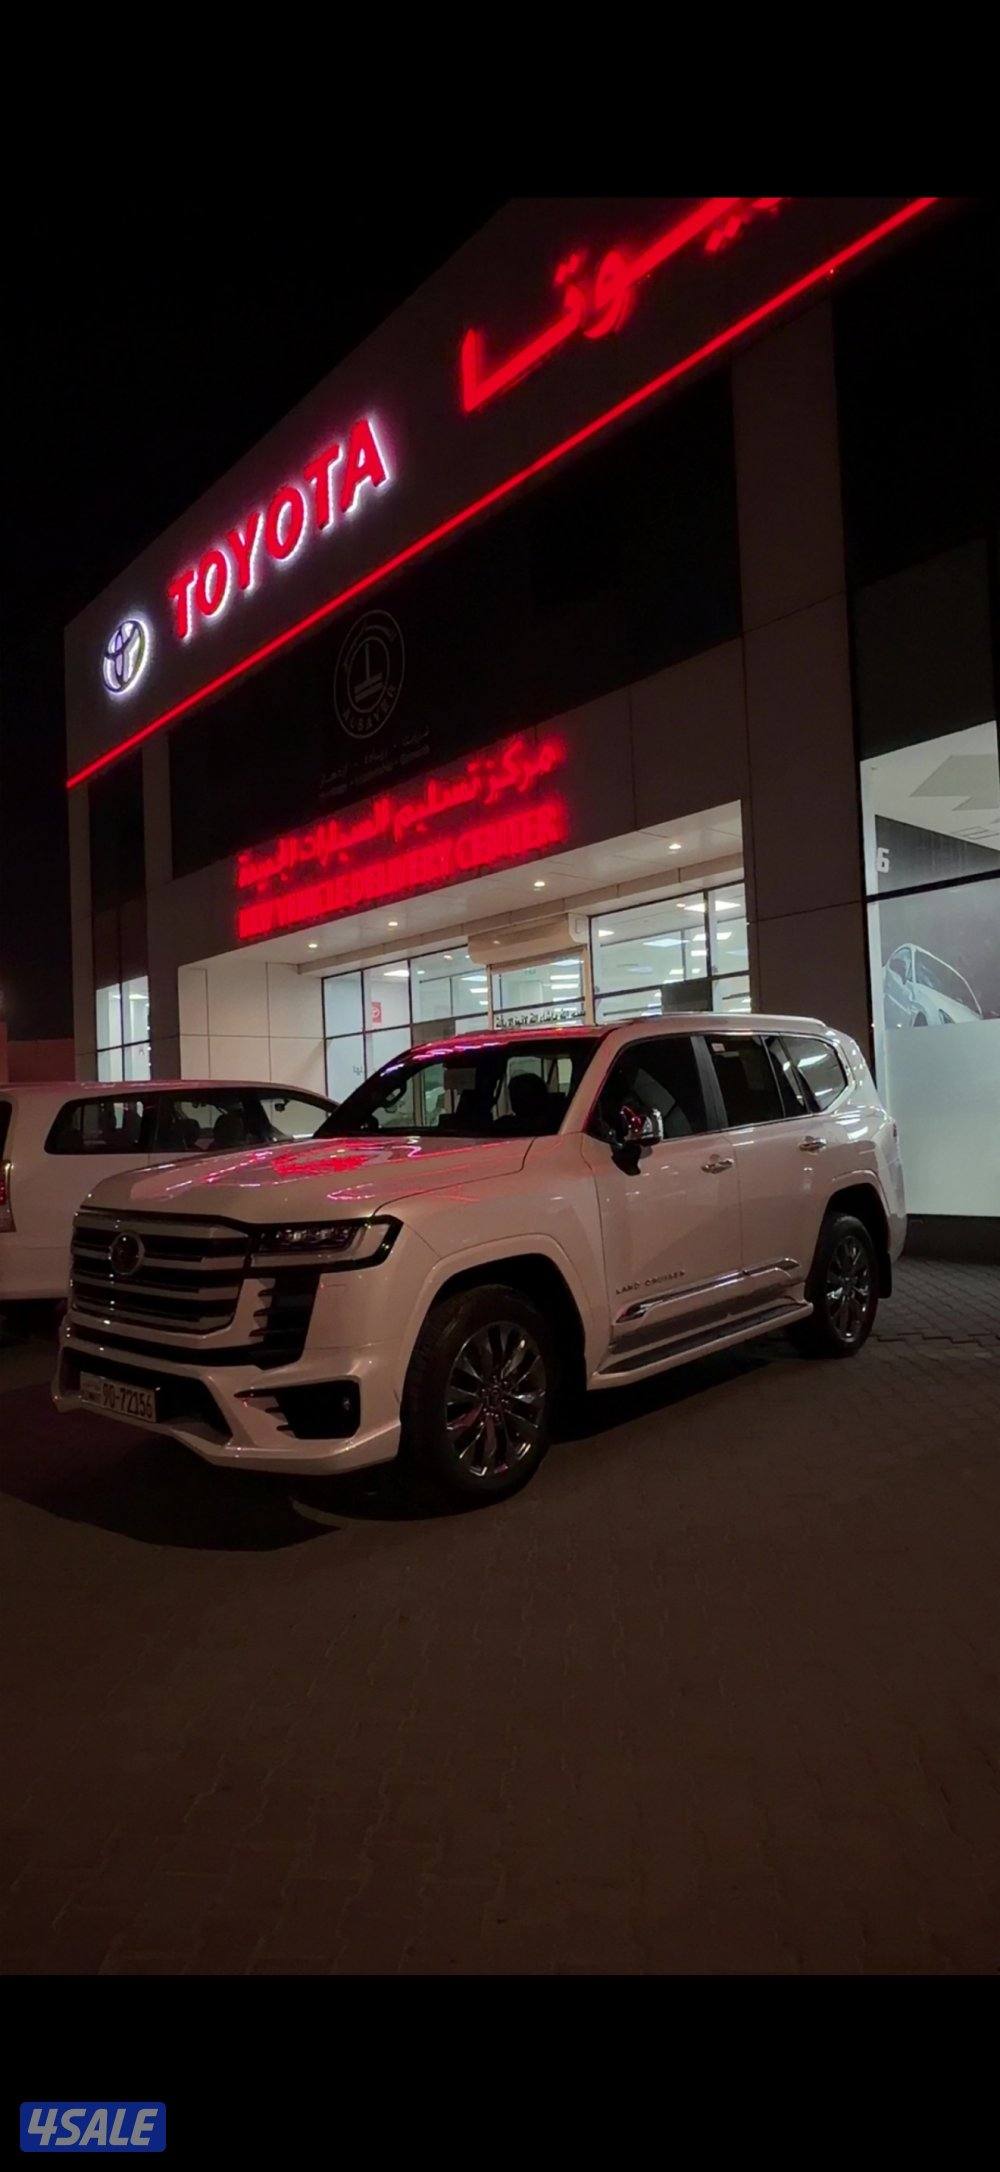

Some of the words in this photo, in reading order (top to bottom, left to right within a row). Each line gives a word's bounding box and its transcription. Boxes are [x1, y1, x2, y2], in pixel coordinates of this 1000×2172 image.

[462, 198, 781, 413] يوتا
[167, 417, 391, 642] TOYOTA
[454, 799, 562, 872] CENTER
[615, 1282, 640, 1295] LAND
